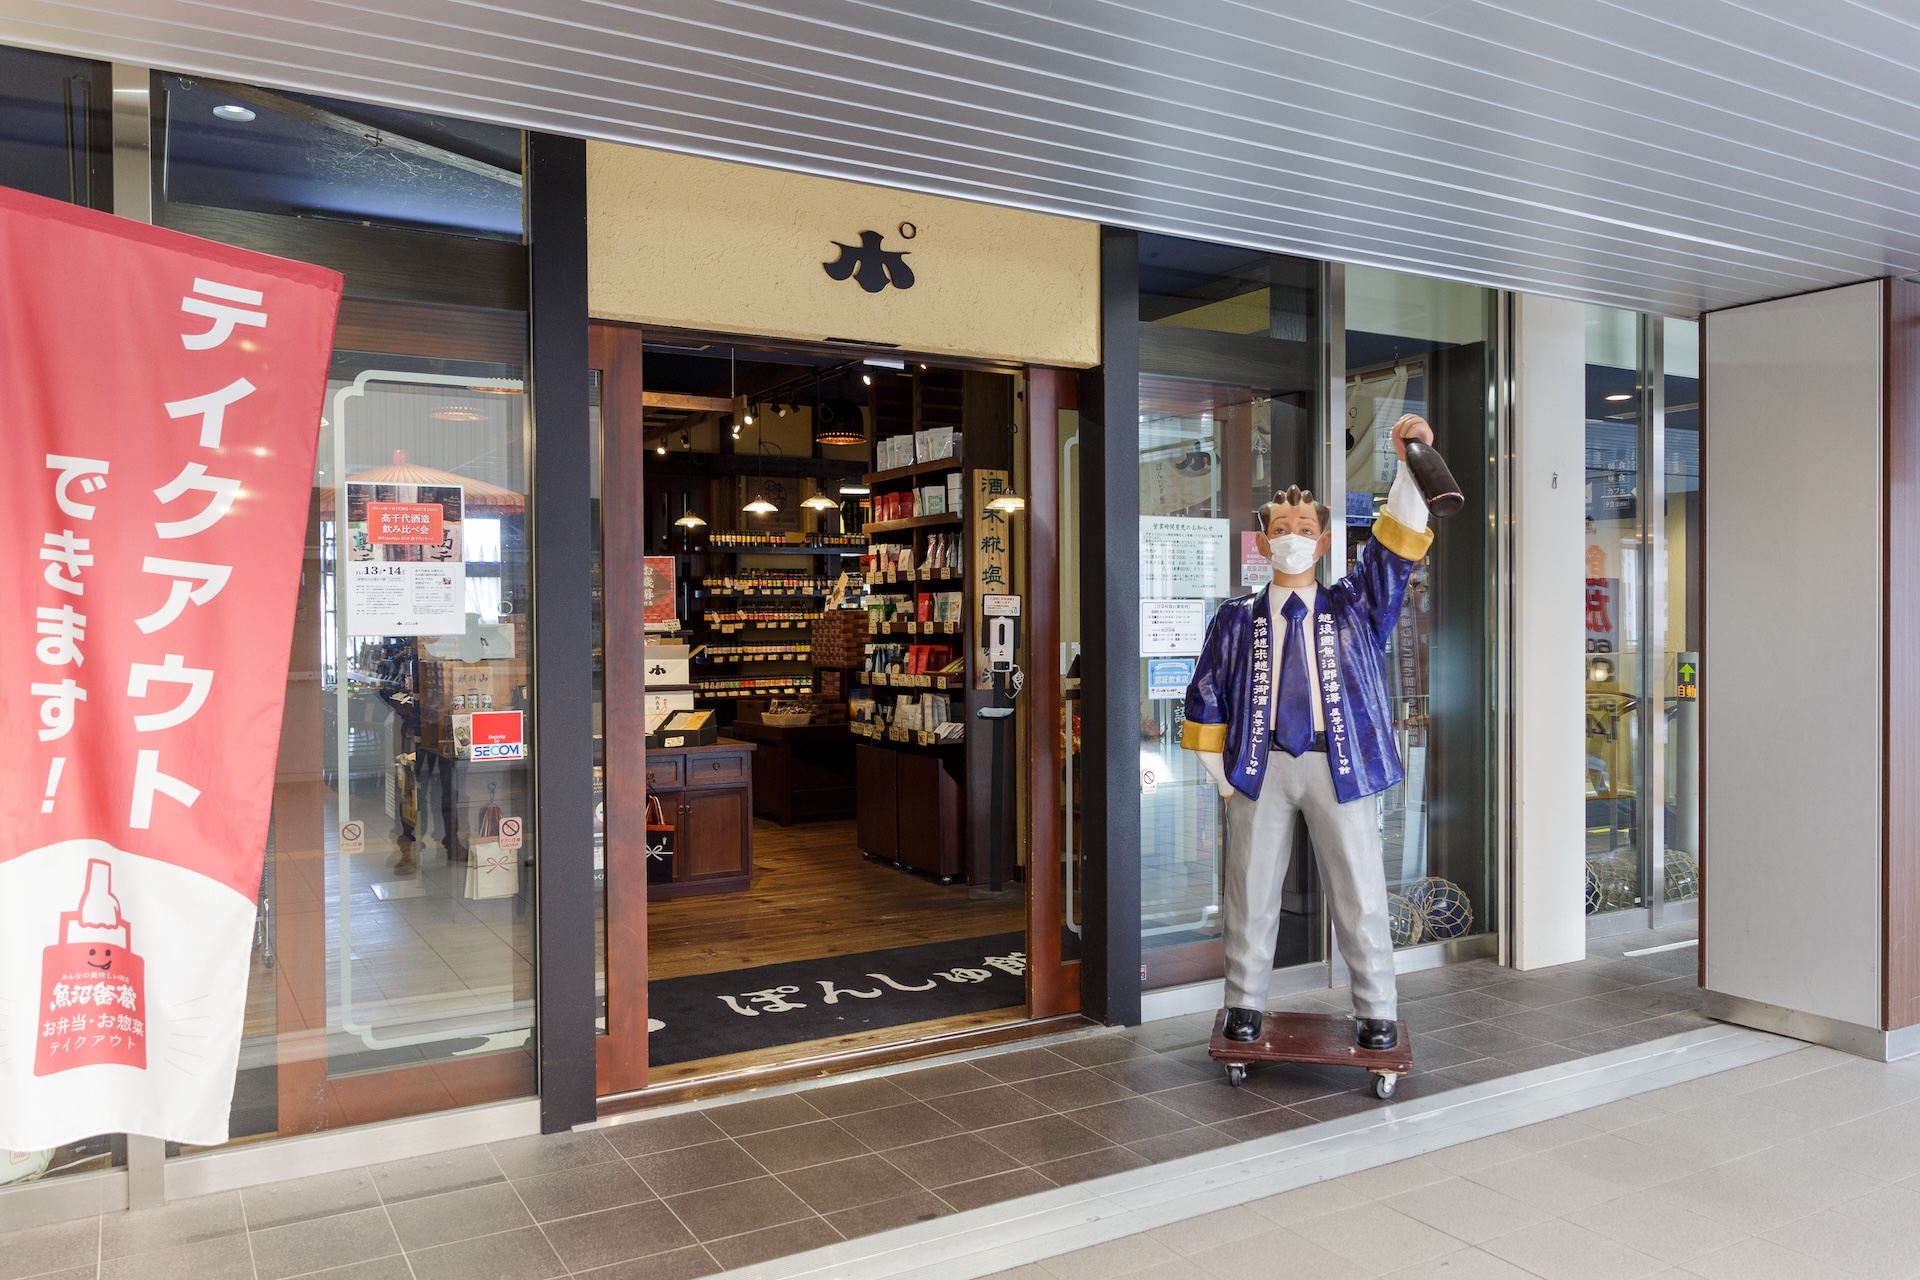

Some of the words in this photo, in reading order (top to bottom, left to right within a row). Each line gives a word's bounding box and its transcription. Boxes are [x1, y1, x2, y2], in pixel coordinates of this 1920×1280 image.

[382, 524, 429, 535] 飲み比べ会
[1153, 523, 1213, 531] 営業時間変更のお知らせ
[126, 277, 268, 829] テイクアウト
[1677, 684, 1697, 699] 自動
[475, 744, 519, 757] SECOM
[43, 1013, 144, 1037] お弁当・お惣菜
[50, 1035, 136, 1057] テイクアウト
